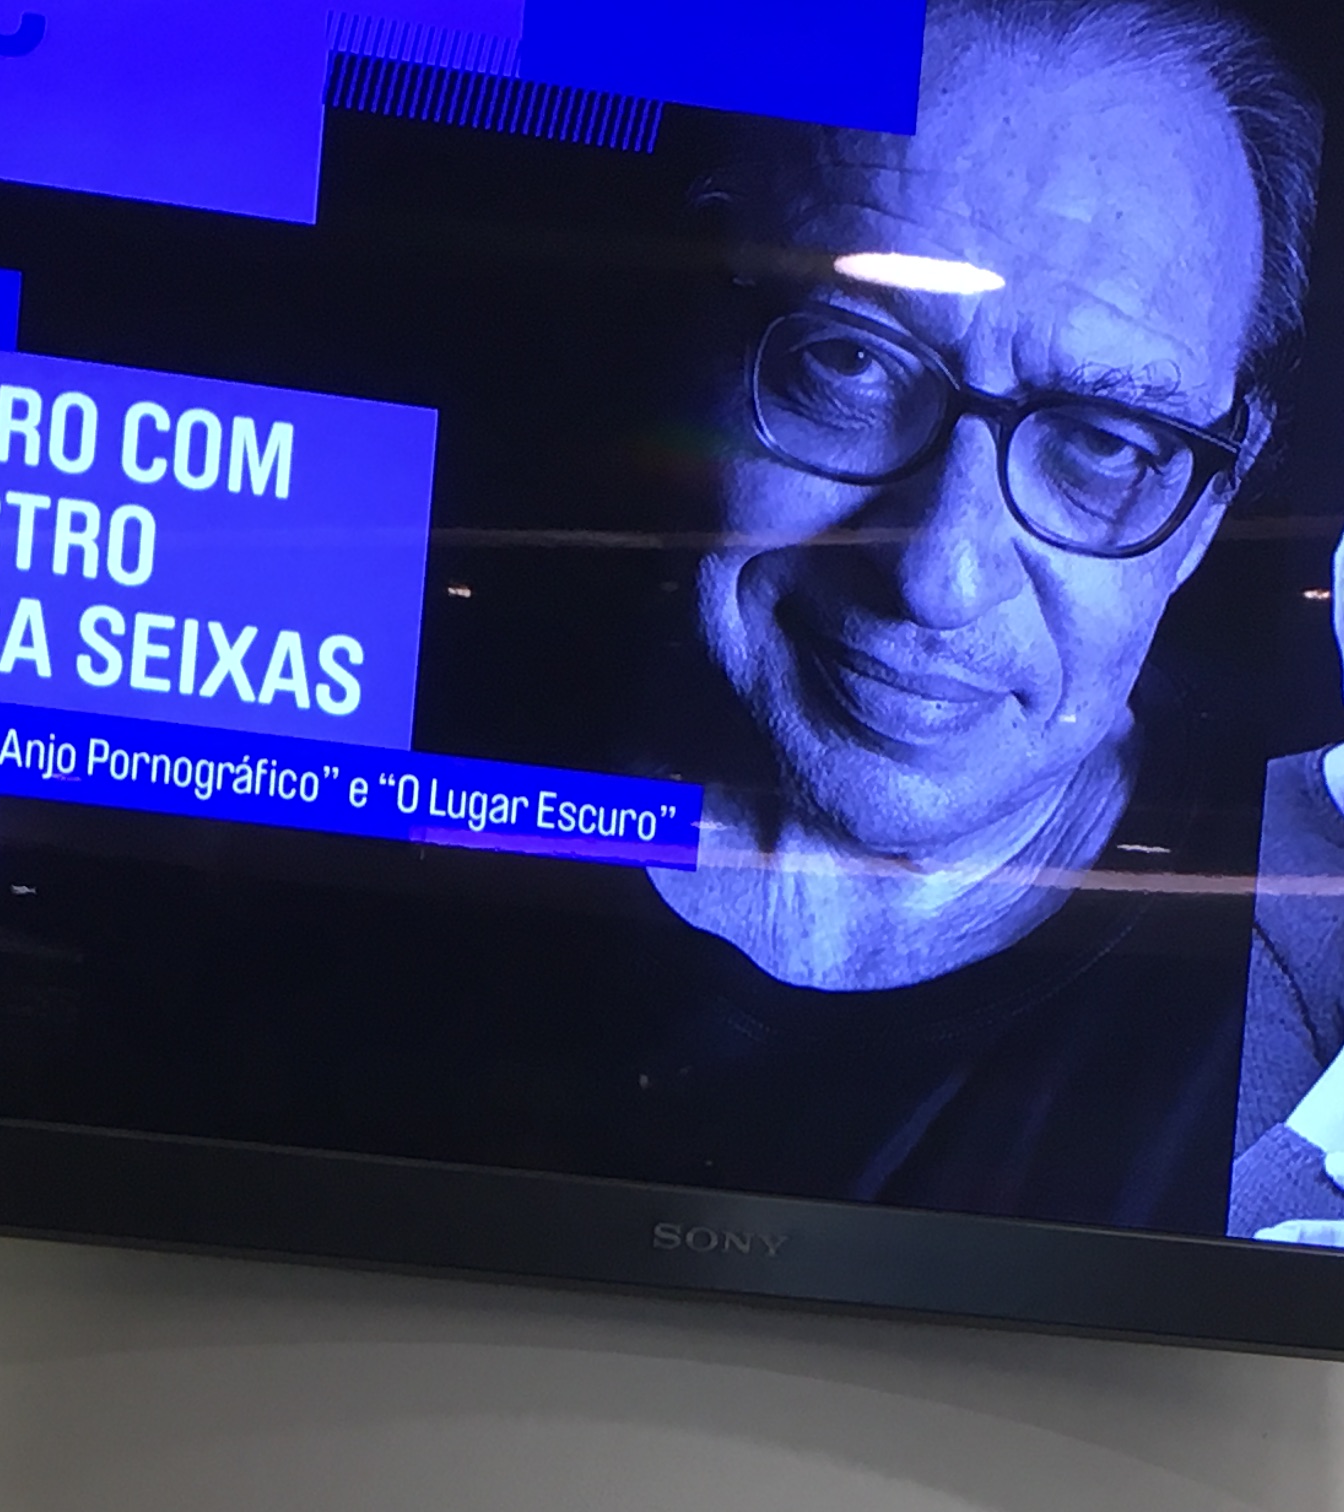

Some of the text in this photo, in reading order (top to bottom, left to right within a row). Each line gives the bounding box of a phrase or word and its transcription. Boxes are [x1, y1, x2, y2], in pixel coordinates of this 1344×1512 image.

[120, 400, 295, 501] COM
[75, 603, 365, 717] SEIXAS
[86, 737, 341, 803] Pornográfico”
[348, 776, 370, 809] e
[428, 777, 530, 833] Lugar
[535, 790, 678, 842] Escuro”
[652, 1222, 789, 1257] SONY
